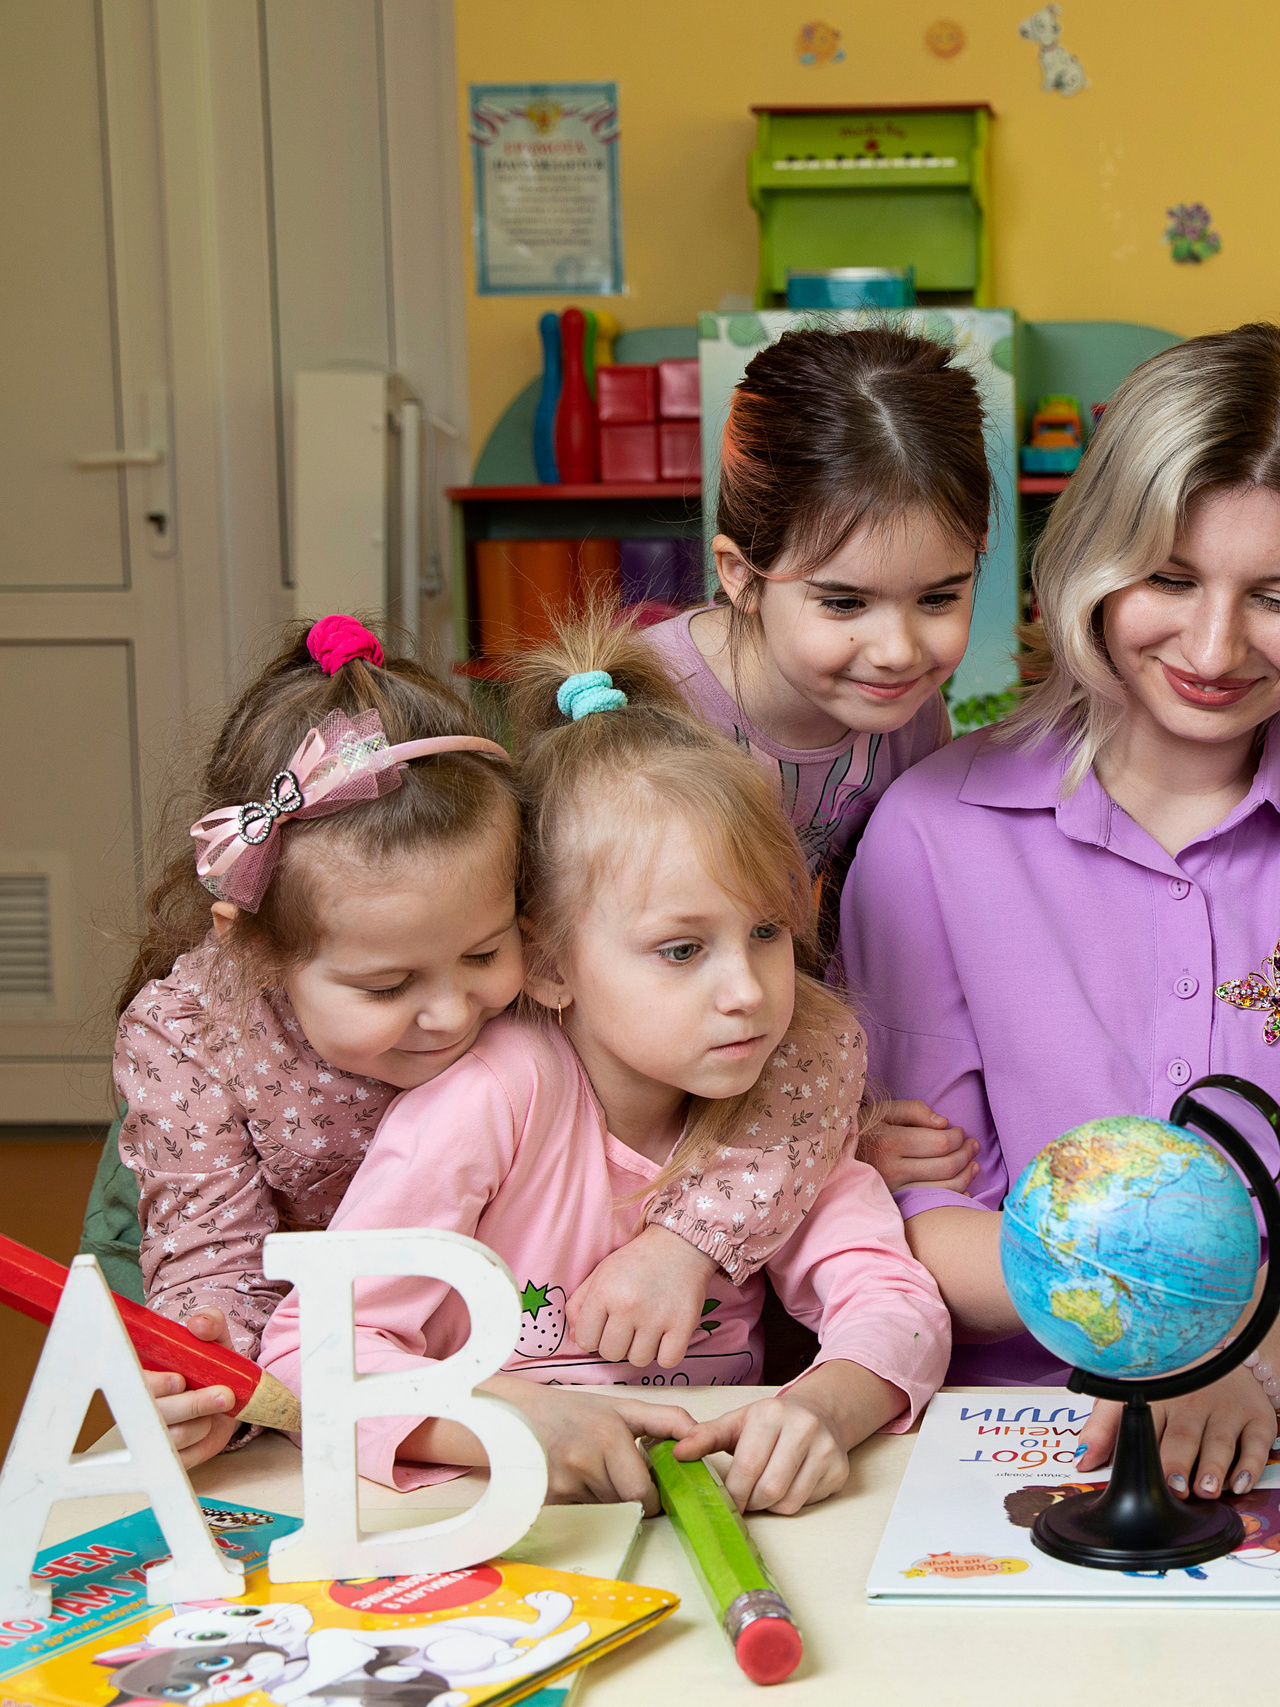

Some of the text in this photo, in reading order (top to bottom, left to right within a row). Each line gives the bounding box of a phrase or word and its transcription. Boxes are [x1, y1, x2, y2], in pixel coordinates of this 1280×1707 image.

[960, 1406, 1092, 1423] илли
[978, 1425, 1083, 1437] мени
[1020, 1438, 1061, 1449] по
[959, 1450, 1076, 1470] обот
[31, 1544, 137, 1581] ЧЕМ
[934, 1562, 999, 1573] Сказки
